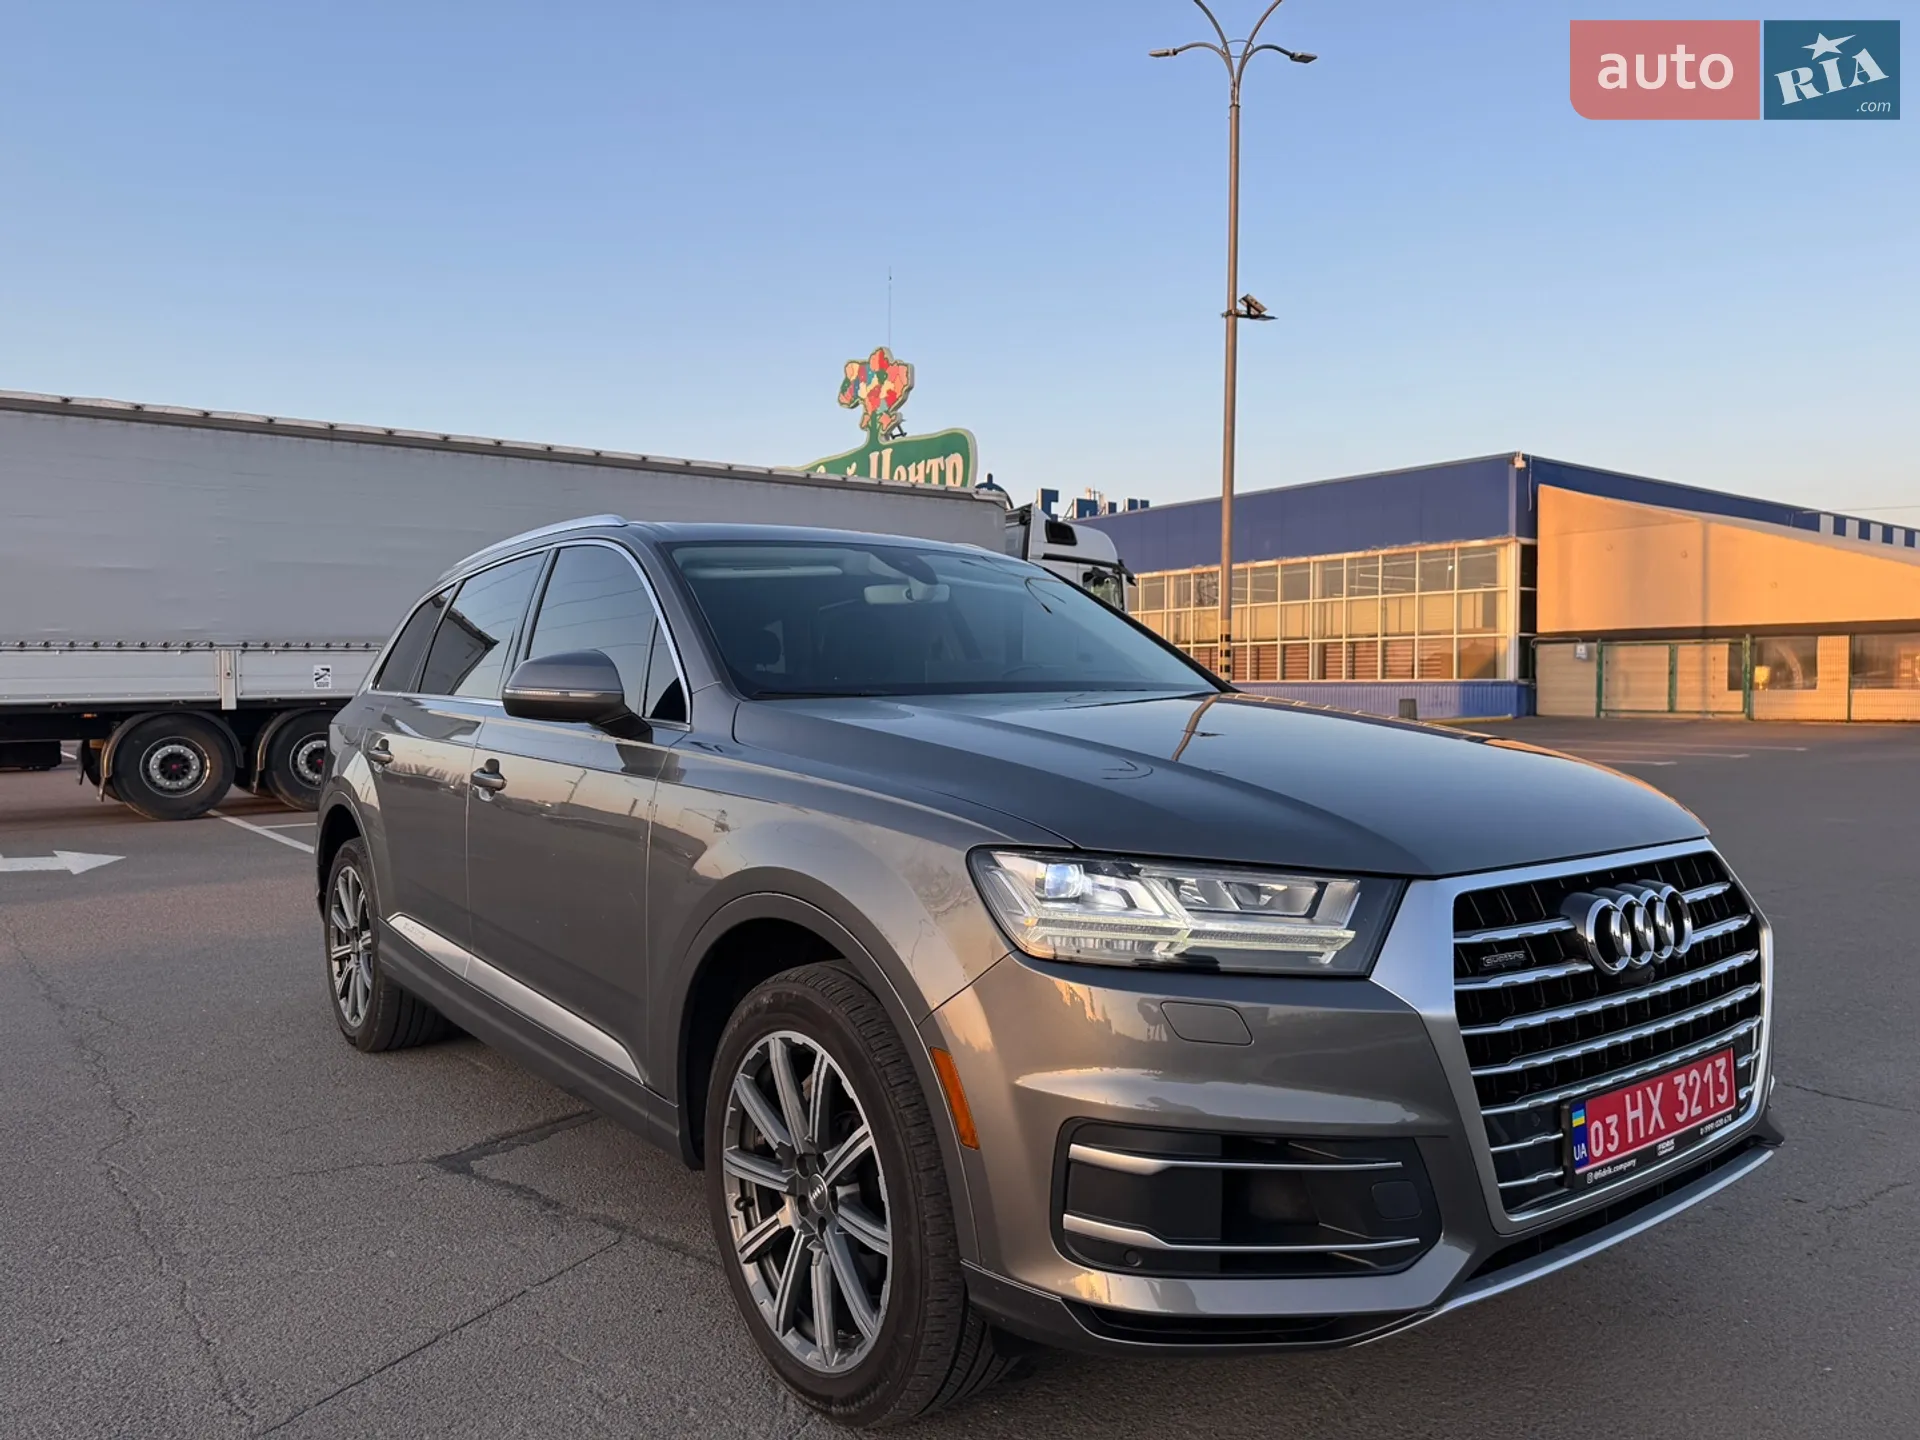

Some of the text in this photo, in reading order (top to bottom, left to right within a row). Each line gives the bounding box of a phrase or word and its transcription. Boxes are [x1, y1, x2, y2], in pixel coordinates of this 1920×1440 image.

[1590, 1113, 1620, 1157] 03
[1673, 1056, 1729, 1123] 3213
[1573, 1142, 1588, 1161] UA
